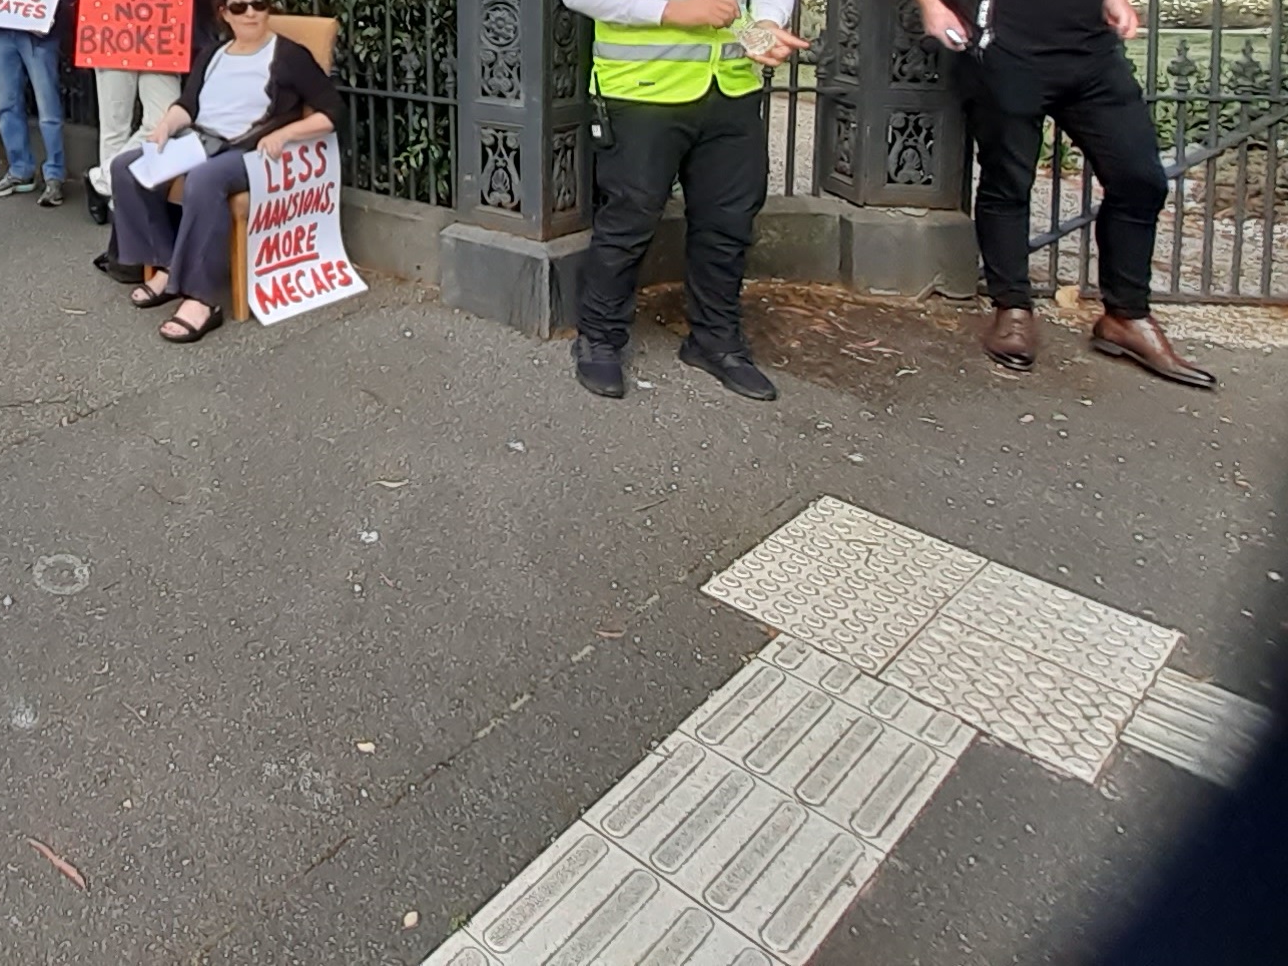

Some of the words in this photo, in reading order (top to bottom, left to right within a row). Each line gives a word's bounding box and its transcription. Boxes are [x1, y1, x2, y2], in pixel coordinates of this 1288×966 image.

[115, 2, 173, 24] NOT
[79, 22, 185, 56] BROKE!
[264, 140, 328, 194] LESS
[248, 181, 335, 236] MANSIONS,
[255, 222, 318, 267] MORE
[254, 260, 353, 315] MECAFS
